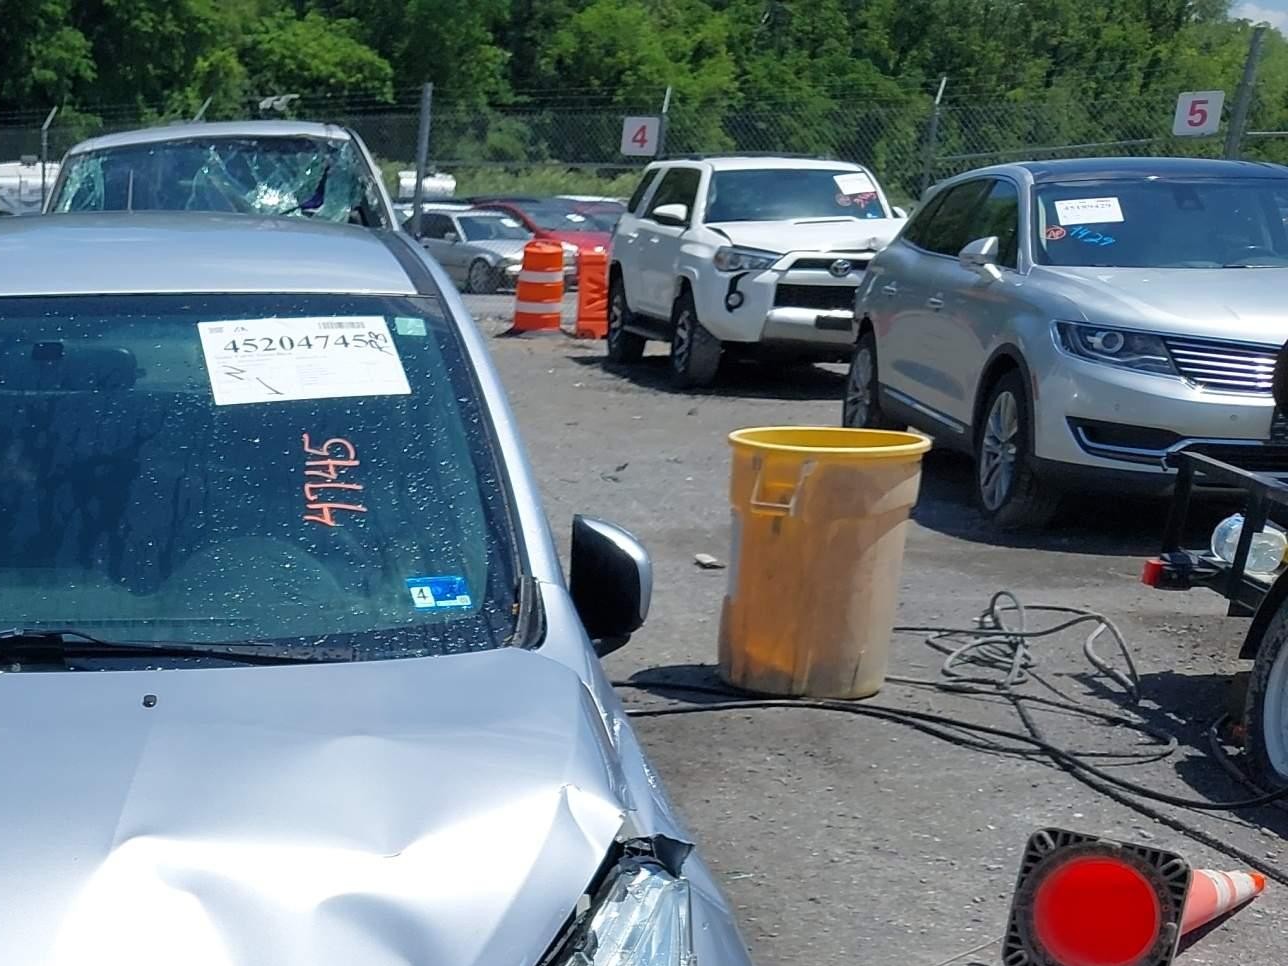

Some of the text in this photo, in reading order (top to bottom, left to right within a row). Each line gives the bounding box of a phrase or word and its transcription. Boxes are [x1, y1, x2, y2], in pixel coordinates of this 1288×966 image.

[1187, 100, 1208, 126] 5
[632, 125, 648, 148] 4
[223, 335, 369, 353] 45204745
[303, 433, 368, 527] 4745
